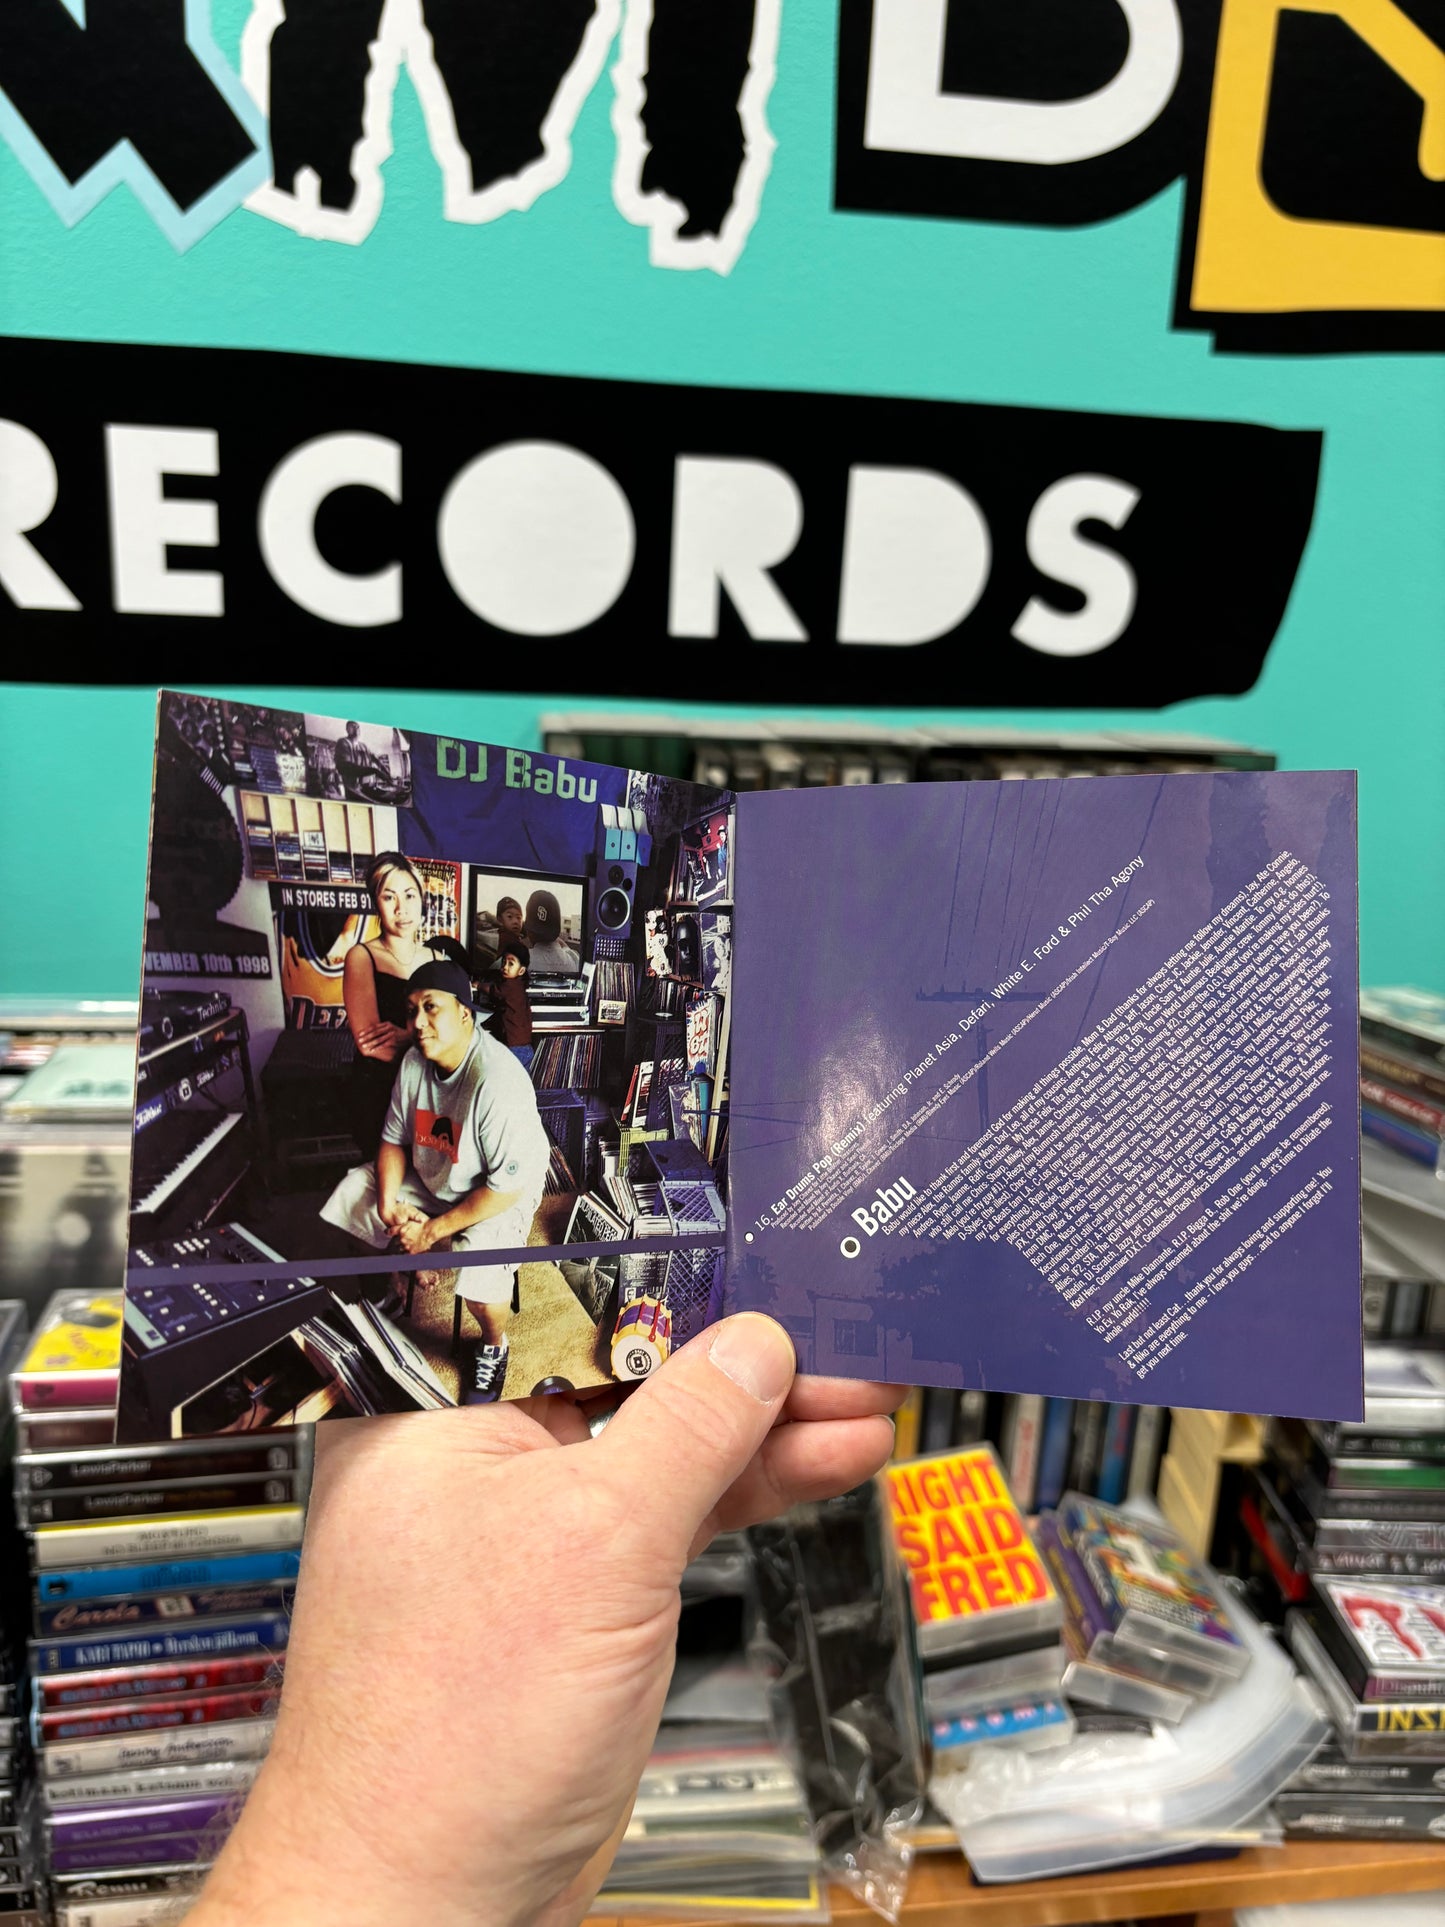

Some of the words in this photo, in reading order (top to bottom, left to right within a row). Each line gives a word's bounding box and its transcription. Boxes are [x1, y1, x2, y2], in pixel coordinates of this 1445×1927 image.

[436, 737, 488, 783] DJ
[505, 748, 598, 803] Babu
[281, 888, 294, 905] IN
[296, 889, 336, 908] STORES
[338, 892, 358, 909] FEB
[201, 953, 233, 972] 10th
[236, 955, 270, 974] 1998
[754, 1212, 776, 1232] 16.
[770, 1197, 790, 1216] Ear
[785, 1171, 816, 1202] Drums
[812, 1152, 834, 1174] Pop
[830, 1123, 865, 1159] (Remix)
[865, 1082, 908, 1124] featuring
[903, 1052, 936, 1084] Planet
[934, 1030, 961, 1055] Asia,
[958, 998, 994, 1031] Defari,
[990, 969, 1023, 999] White
[1020, 957, 1036, 972] E.
[1033, 934, 1059, 959] Ford
[1057, 924, 1070, 937] &
[1067, 903, 1091, 927] Phil
[1088, 884, 1112, 906] Tha
[1110, 854, 1145, 888] Agony
[881, 1217, 900, 1235] Babu
[897, 1201, 916, 1221] would
[912, 1193, 926, 1206] like
[928, 1172, 948, 1190] thank
[944, 1161, 959, 1175] first
[956, 1150, 970, 1165] and
[966, 1128, 994, 1154] foremost
[990, 1117, 1005, 1132] God
[1001, 1109, 1013, 1121] for
[1010, 1090, 1035, 1114] making
[1031, 1082, 1042, 1094] all
[1038, 1066, 1061, 1087] things
[1057, 1044, 1085, 1070] possible,
[1080, 1030, 1099, 1047] Mom
[1101, 1012, 1117, 1028] Dad
[1114, 992, 1139, 1016] (thanks
[1135, 984, 1147, 995] for
[1145, 965, 1168, 988] always
[1163, 948, 1187, 969] letting
[1192, 922, 1213, 942] follow
[1219, 889, 1249, 916] dreams),
[1244, 879, 1260, 893] Jay,
[1255, 868, 1269, 882] Ate
[1265, 849, 1292, 872] Connie,
[851, 1174, 916, 1235] Babu
[1069, 1293, 1085, 1309] Kool
[1095, 1253, 1129, 1285] Grandmixer
[1172, 1195, 1194, 1214] Flash,
[1189, 1180, 1210, 1199] Africa
[1235, 1142, 1250, 1157] and
[1247, 1129, 1266, 1147] every
[1261, 1116, 1279, 1133] dope
[1282, 1098, 1298, 1113] who
[1293, 1077, 1321, 1103] inspired
[1317, 1069, 1331, 1082] me.
[1101, 1315, 1115, 1328] Ev,
[1118, 1296, 1136, 1312] Rak,
[1132, 1285, 1147, 1300] I've
[1144, 1267, 1167, 1290] always
[1164, 1243, 1192, 1271] dreamed
[1189, 1225, 1210, 1247] about
[1204, 1218, 1220, 1232] the
[1217, 1207, 1232, 1222] shit
[1229, 1192, 1249, 1211] we're
[1277, 1149, 1296, 1166] time
[1299, 1126, 1321, 1146] Dilate
[1317, 1116, 1332, 1130] the
[1111, 1285, 1130, 1303] uncle
[1126, 1271, 1145, 1288] Mike
[1141, 1245, 1175, 1275] Diamante,
[1186, 1214, 1208, 1234] Bigga
[1213, 1193, 1230, 1208] Rob
[1226, 1182, 1243, 1197] One
[1239, 1164, 1261, 1186] (you'll
[1258, 1145, 1283, 1169] always
[1288, 1100, 1332, 1141] remembered),
[1118, 1344, 1135, 1360] Last
[1131, 1334, 1145, 1348] but
[1142, 1326, 1155, 1339] not
[1151, 1312, 1170, 1330] least
[1202, 1272, 1216, 1286] you
[1211, 1263, 1224, 1275] for
[1221, 1245, 1245, 1268] always
[1240, 1228, 1264, 1249] loving
[1259, 1216, 1275, 1232] and
[1272, 1189, 1307, 1222] supporting
[1303, 1177, 1319, 1192] me!
[1316, 1165, 1332, 1179] You
[1132, 1347, 1149, 1363] Niko
[1147, 1338, 1160, 1351] are
[1157, 1311, 1191, 1342] everything
[1211, 1276, 1228, 1291] love
[1225, 1267, 1239, 1281] you
[1278, 1210, 1302, 1233] anyone
[1301, 1188, 1324, 1210] forgot
[1319, 1181, 1332, 1193] I'll
[1102, 1324, 1123, 1343] whole
[1135, 1364, 1149, 1379] get
[1145, 1355, 1160, 1370] you
[1156, 1343, 1172, 1358] next
[1168, 1329, 1188, 1347] time.
[896, 1506, 1023, 1571] SAID
[910, 1554, 1048, 1625] FRED
